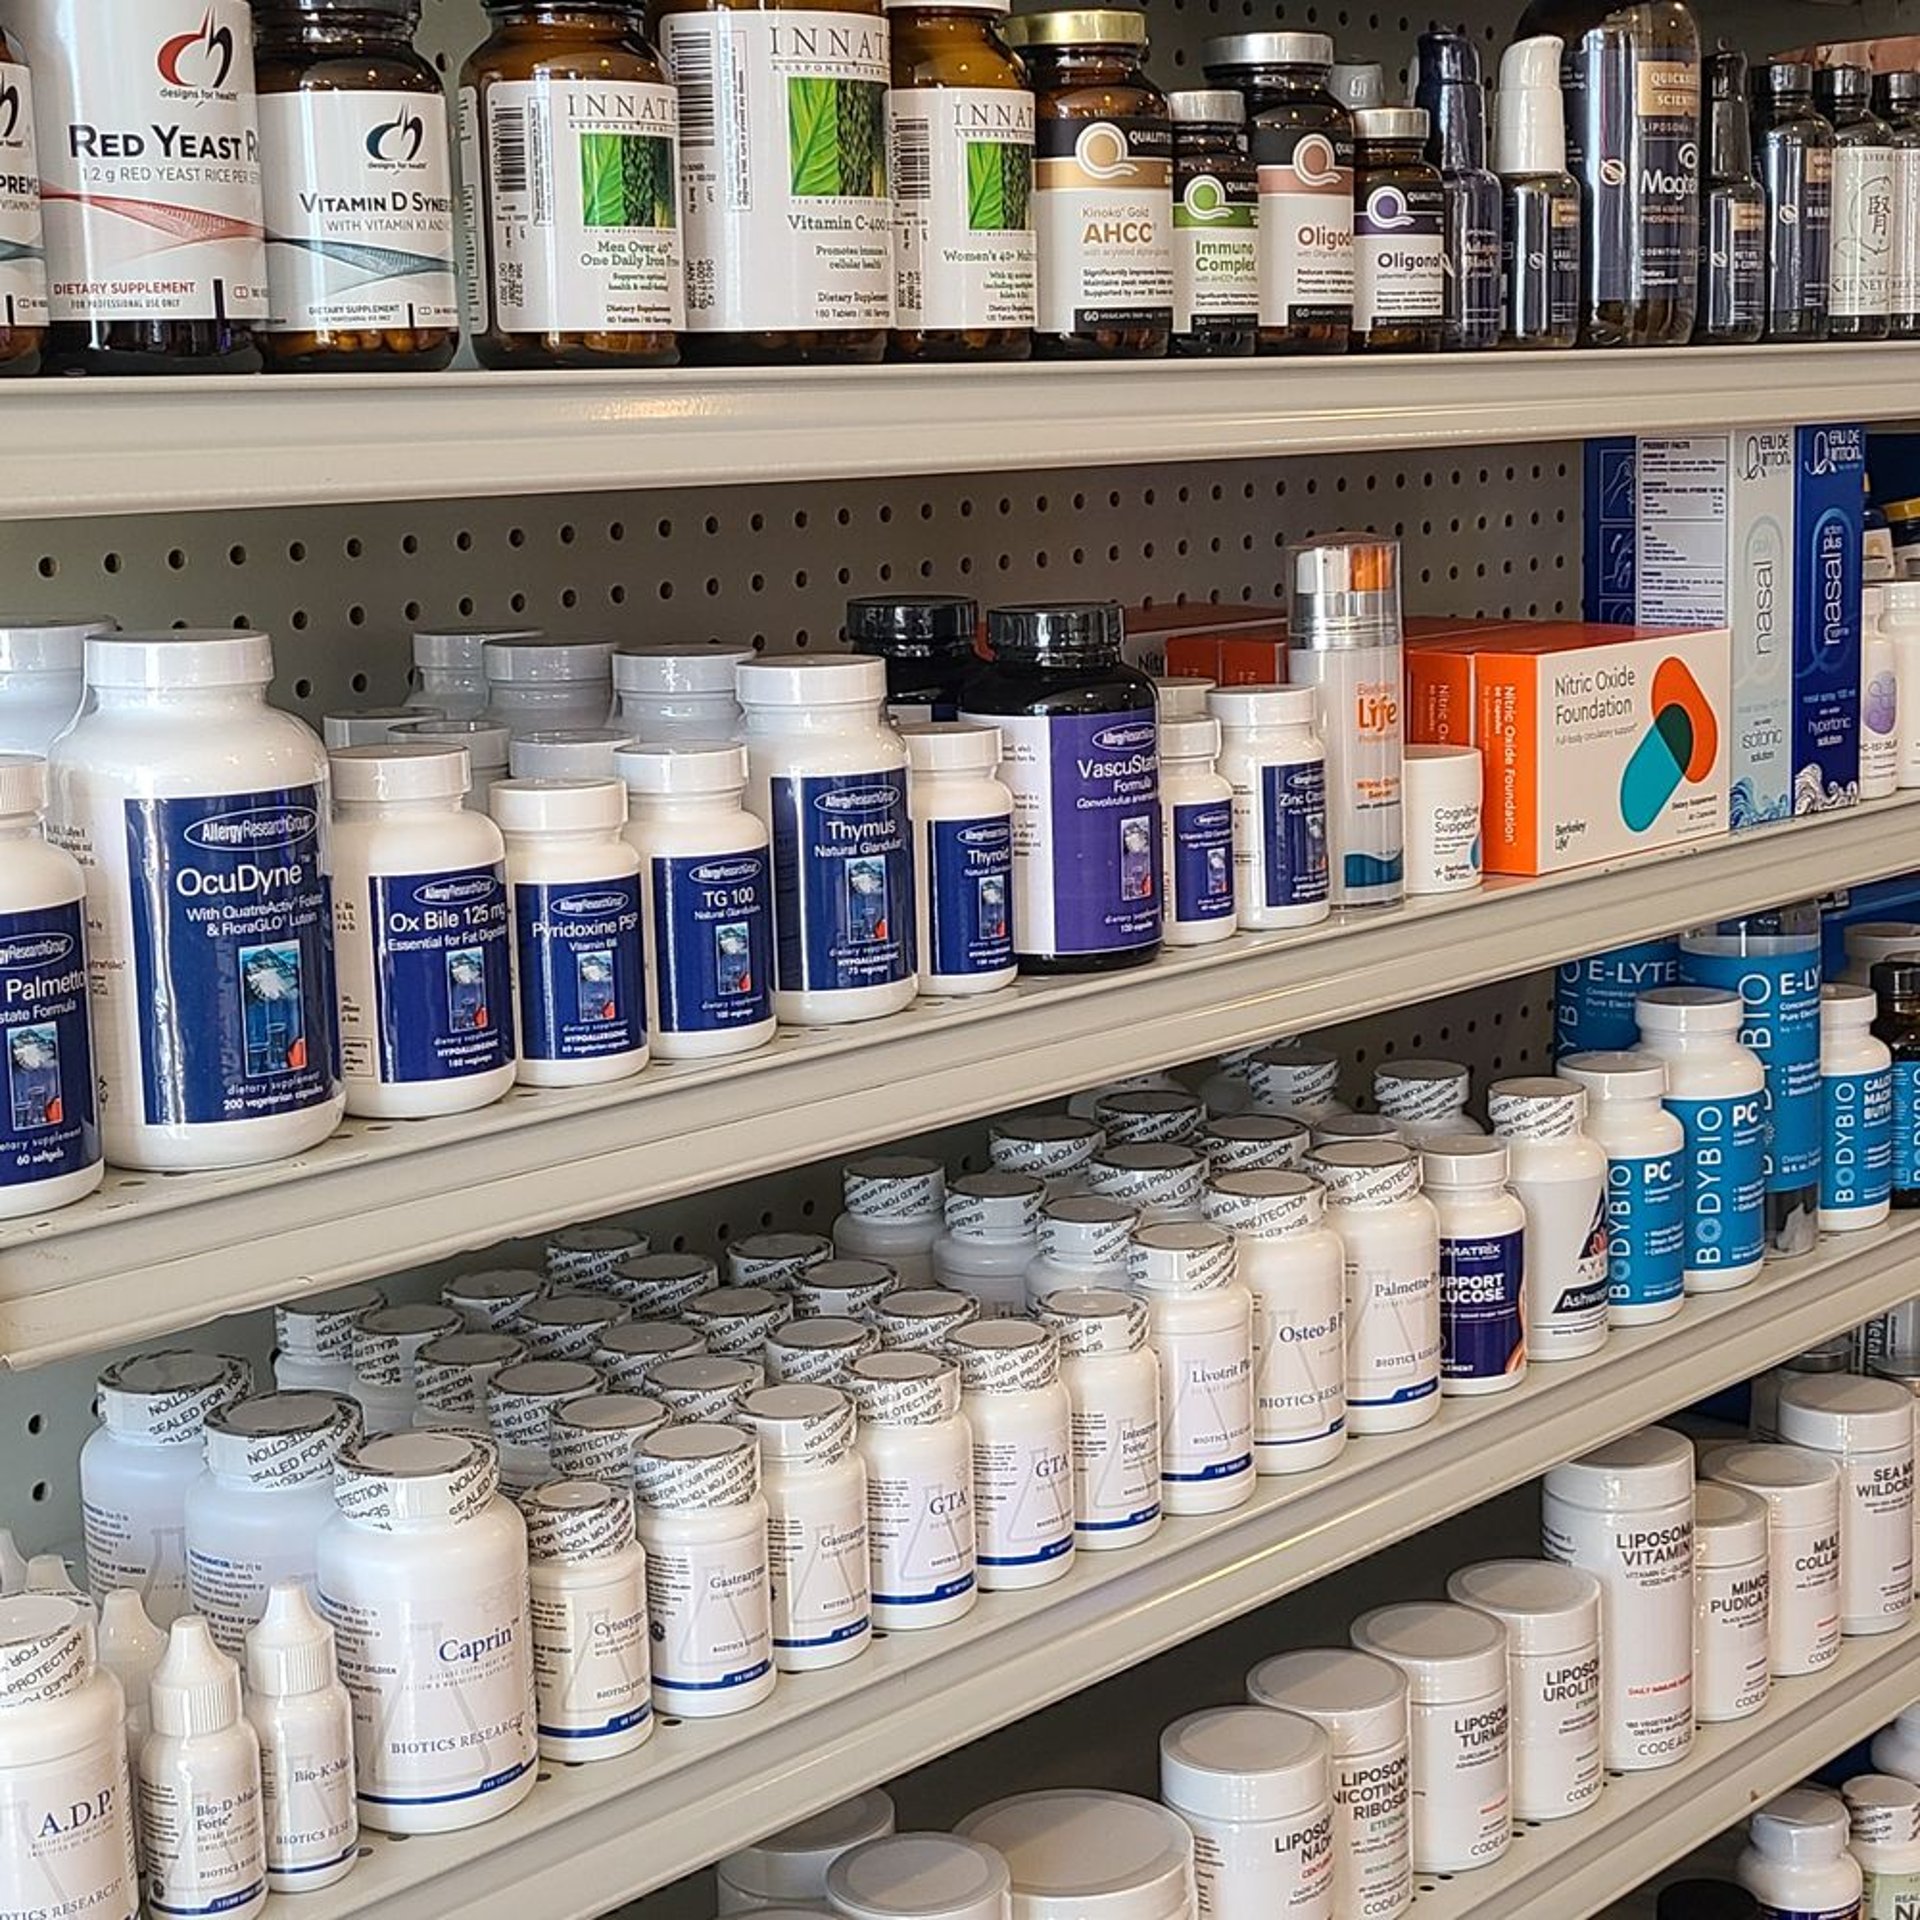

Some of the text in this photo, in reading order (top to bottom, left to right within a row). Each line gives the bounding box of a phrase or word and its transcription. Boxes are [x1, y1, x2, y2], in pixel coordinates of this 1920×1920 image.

[769, 26, 890, 60] INNAT
[160, 88, 199, 100] designs
[953, 103, 1035, 128] INNAT
[68, 124, 146, 158] RED
[151, 125, 242, 160] YEAST
[120, 167, 151, 181] RED
[157, 167, 200, 182] YEAST
[205, 168, 232, 183] RICE
[300, 192, 407, 213] VITAMIN D
[327, 219, 413, 231] WITH VITAMIN
[788, 214, 851, 231] Vitamin
[598, 241, 655, 253] Men Over
[581, 254, 643, 268] One Daily
[54, 281, 196, 296] DIETARY SUPPLEMENT
[817, 291, 851, 303] Dietary
[1752, 558, 1774, 656] nasal
[1819, 552, 1844, 646] nasal
[1555, 665, 1636, 698] Nitric Oxide
[1358, 696, 1398, 733] Life
[1556, 695, 1633, 726] Foundation
[1503, 685, 1517, 843] Nitric Oxide Foundation
[827, 818, 897, 841] Thymus
[814, 843, 858, 858] Natural
[702, 886, 756, 908] TG 100
[186, 906, 220, 922] With
[390, 912, 420, 933] Ox
[424, 910, 460, 931] Bile
[463, 904, 489, 926] 125
[694, 909, 725, 921] Natural
[206, 922, 219, 937] &
[531, 918, 618, 940] Pyridoxine
[387, 930, 479, 952] Essential for Fat
[569, 940, 605, 953] Vitamin
[1588, 959, 1678, 985] E-LYTE
[33, 999, 78, 1020] Formula
[227, 1079, 268, 1096] dietary
[223, 1098, 244, 1112] 200
[1732, 1102, 1758, 1128] PC
[1834, 1082, 1856, 1203] BODYBIO
[1643, 1161, 1672, 1185] PC
[1696, 1105, 1722, 1264] BODYBIO
[1608, 1165, 1632, 1299] BODYBIO
[1440, 1286, 1505, 1304] UCOSE
[1259, 1393, 1317, 1409] BIOTICS
[301, 1440, 327, 1463] FOR
[1036, 1454, 1069, 1479] GTA
[1873, 1465, 1900, 1483] SEA
[929, 1489, 966, 1516] GTA
[439, 1626, 513, 1664] Caprin
[1546, 1658, 1599, 1687] LIPOSO
[1543, 1674, 1599, 1702] UROLIT
[391, 1733, 456, 1755] BIOTICS
[1274, 1813, 1332, 1854] LIPOSO
